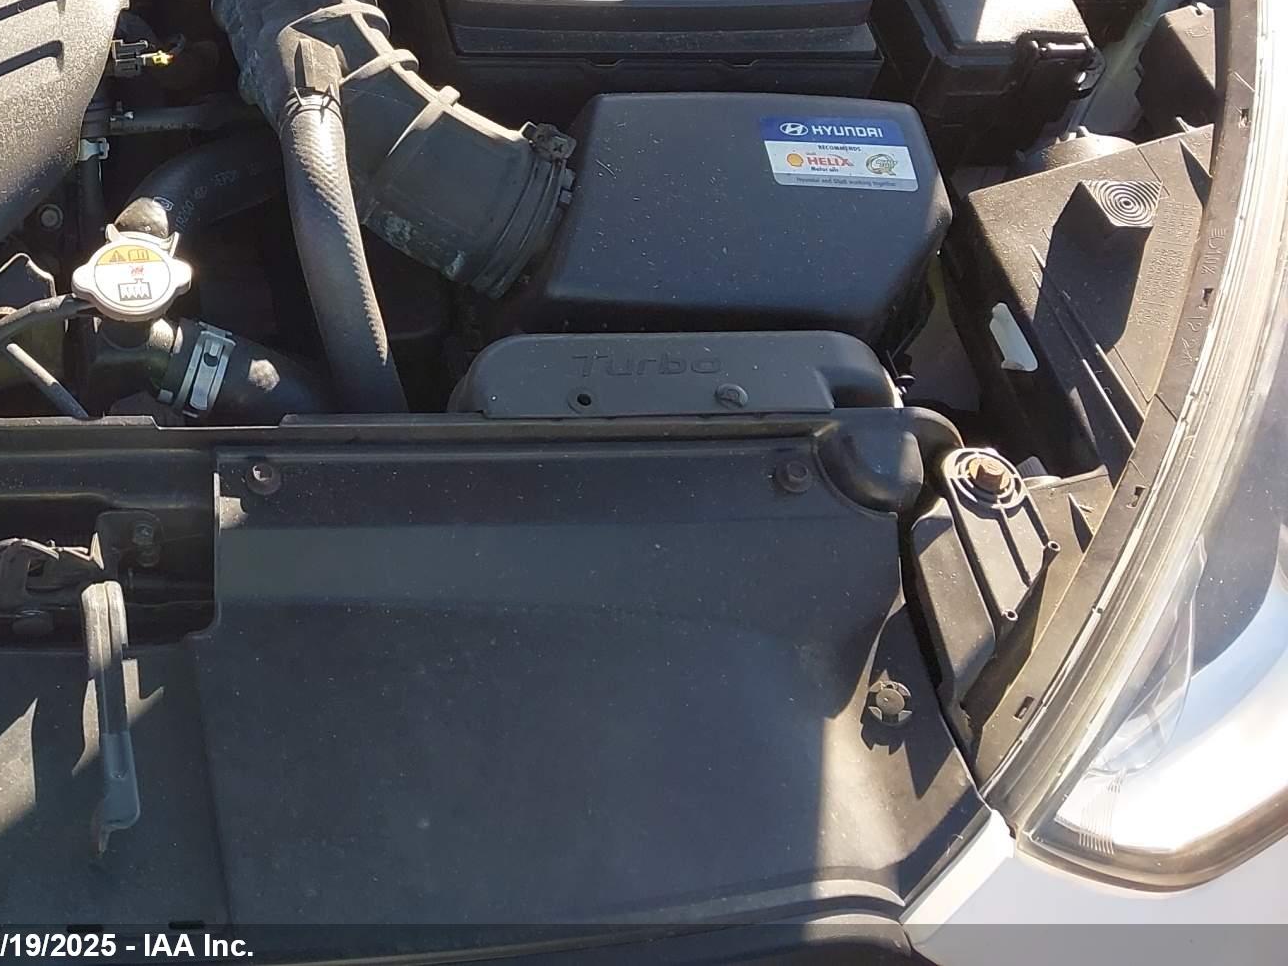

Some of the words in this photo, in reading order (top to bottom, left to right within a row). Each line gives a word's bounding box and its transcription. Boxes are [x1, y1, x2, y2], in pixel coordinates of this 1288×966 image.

[812, 125, 884, 138] HYUNDAI
[817, 144, 862, 152] RECOMMENDS
[806, 156, 854, 167] HELIX
[571, 351, 722, 378] Turbo
